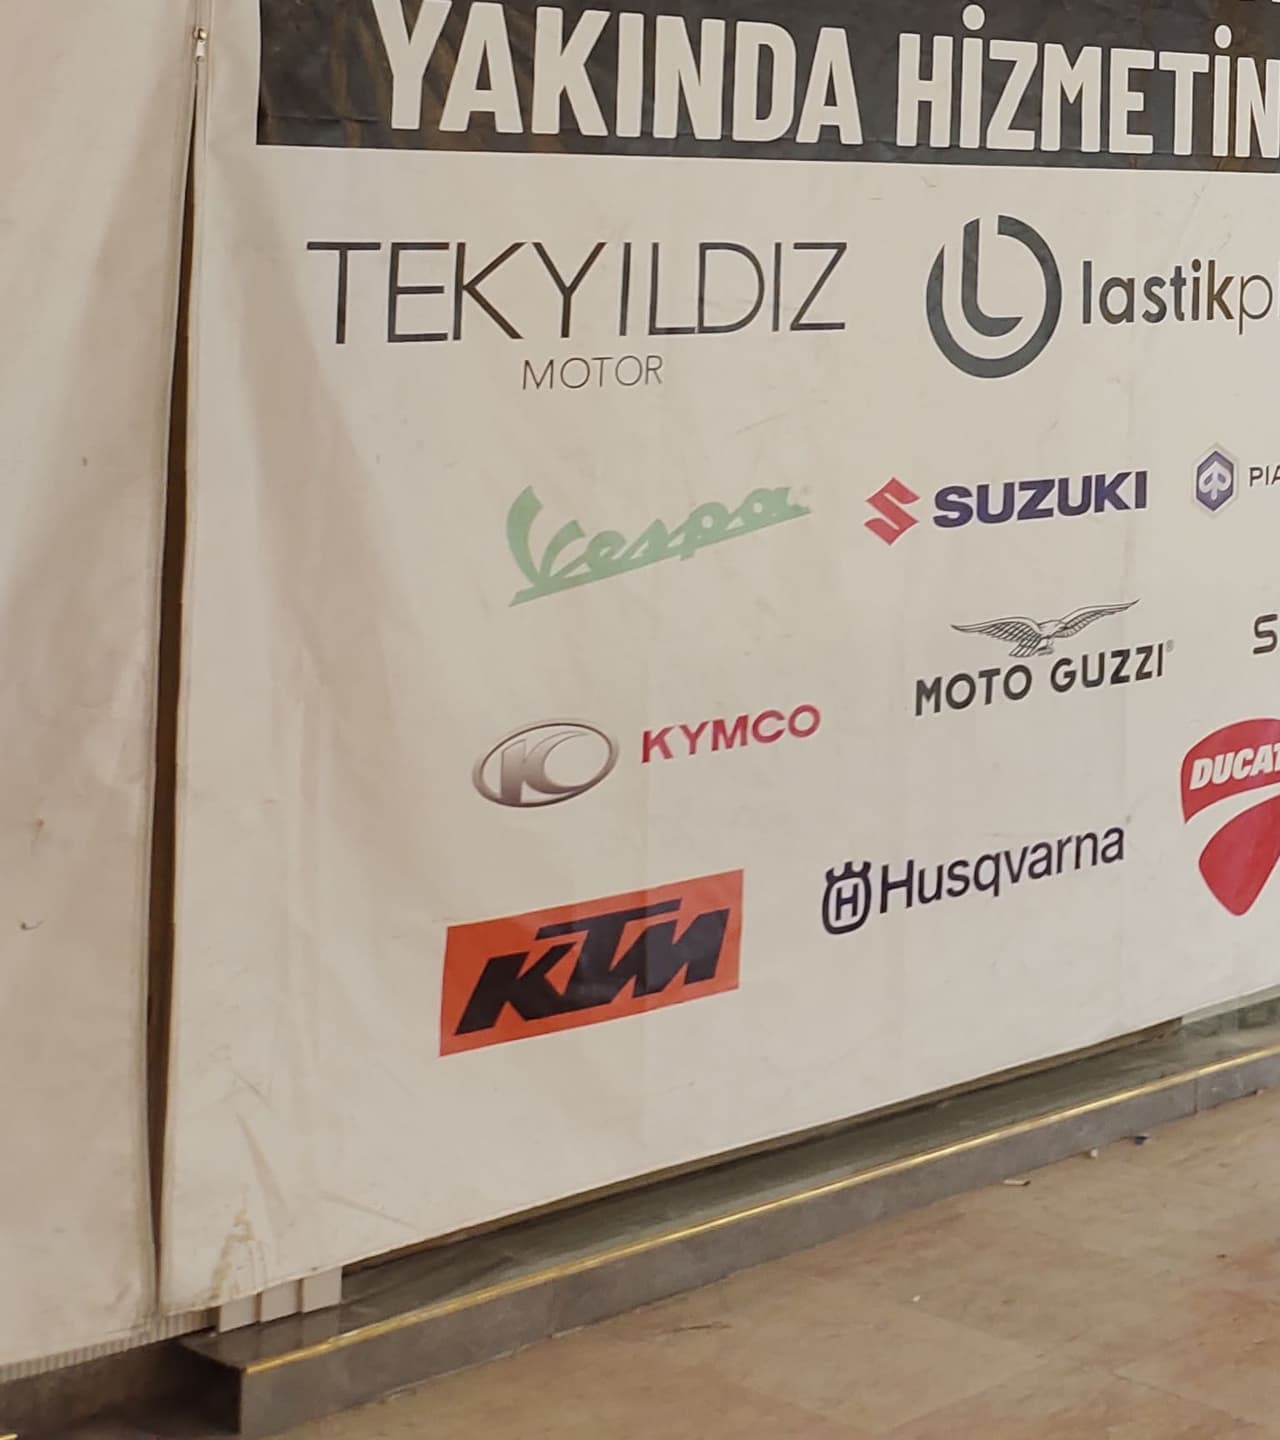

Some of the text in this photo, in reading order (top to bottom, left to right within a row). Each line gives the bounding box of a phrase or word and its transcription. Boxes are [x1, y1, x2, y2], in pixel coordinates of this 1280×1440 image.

[306, 242, 848, 345] TEKYILDIZ
[522, 355, 664, 390] MOTOR
[933, 470, 1148, 528] SUZUKI
[508, 485, 812, 607] Vespa
[915, 642, 1165, 716] MOTO GUZZI
[641, 704, 821, 763] KYMCO
[879, 825, 1126, 913] Husqvarna
[454, 898, 730, 1035] KTM
